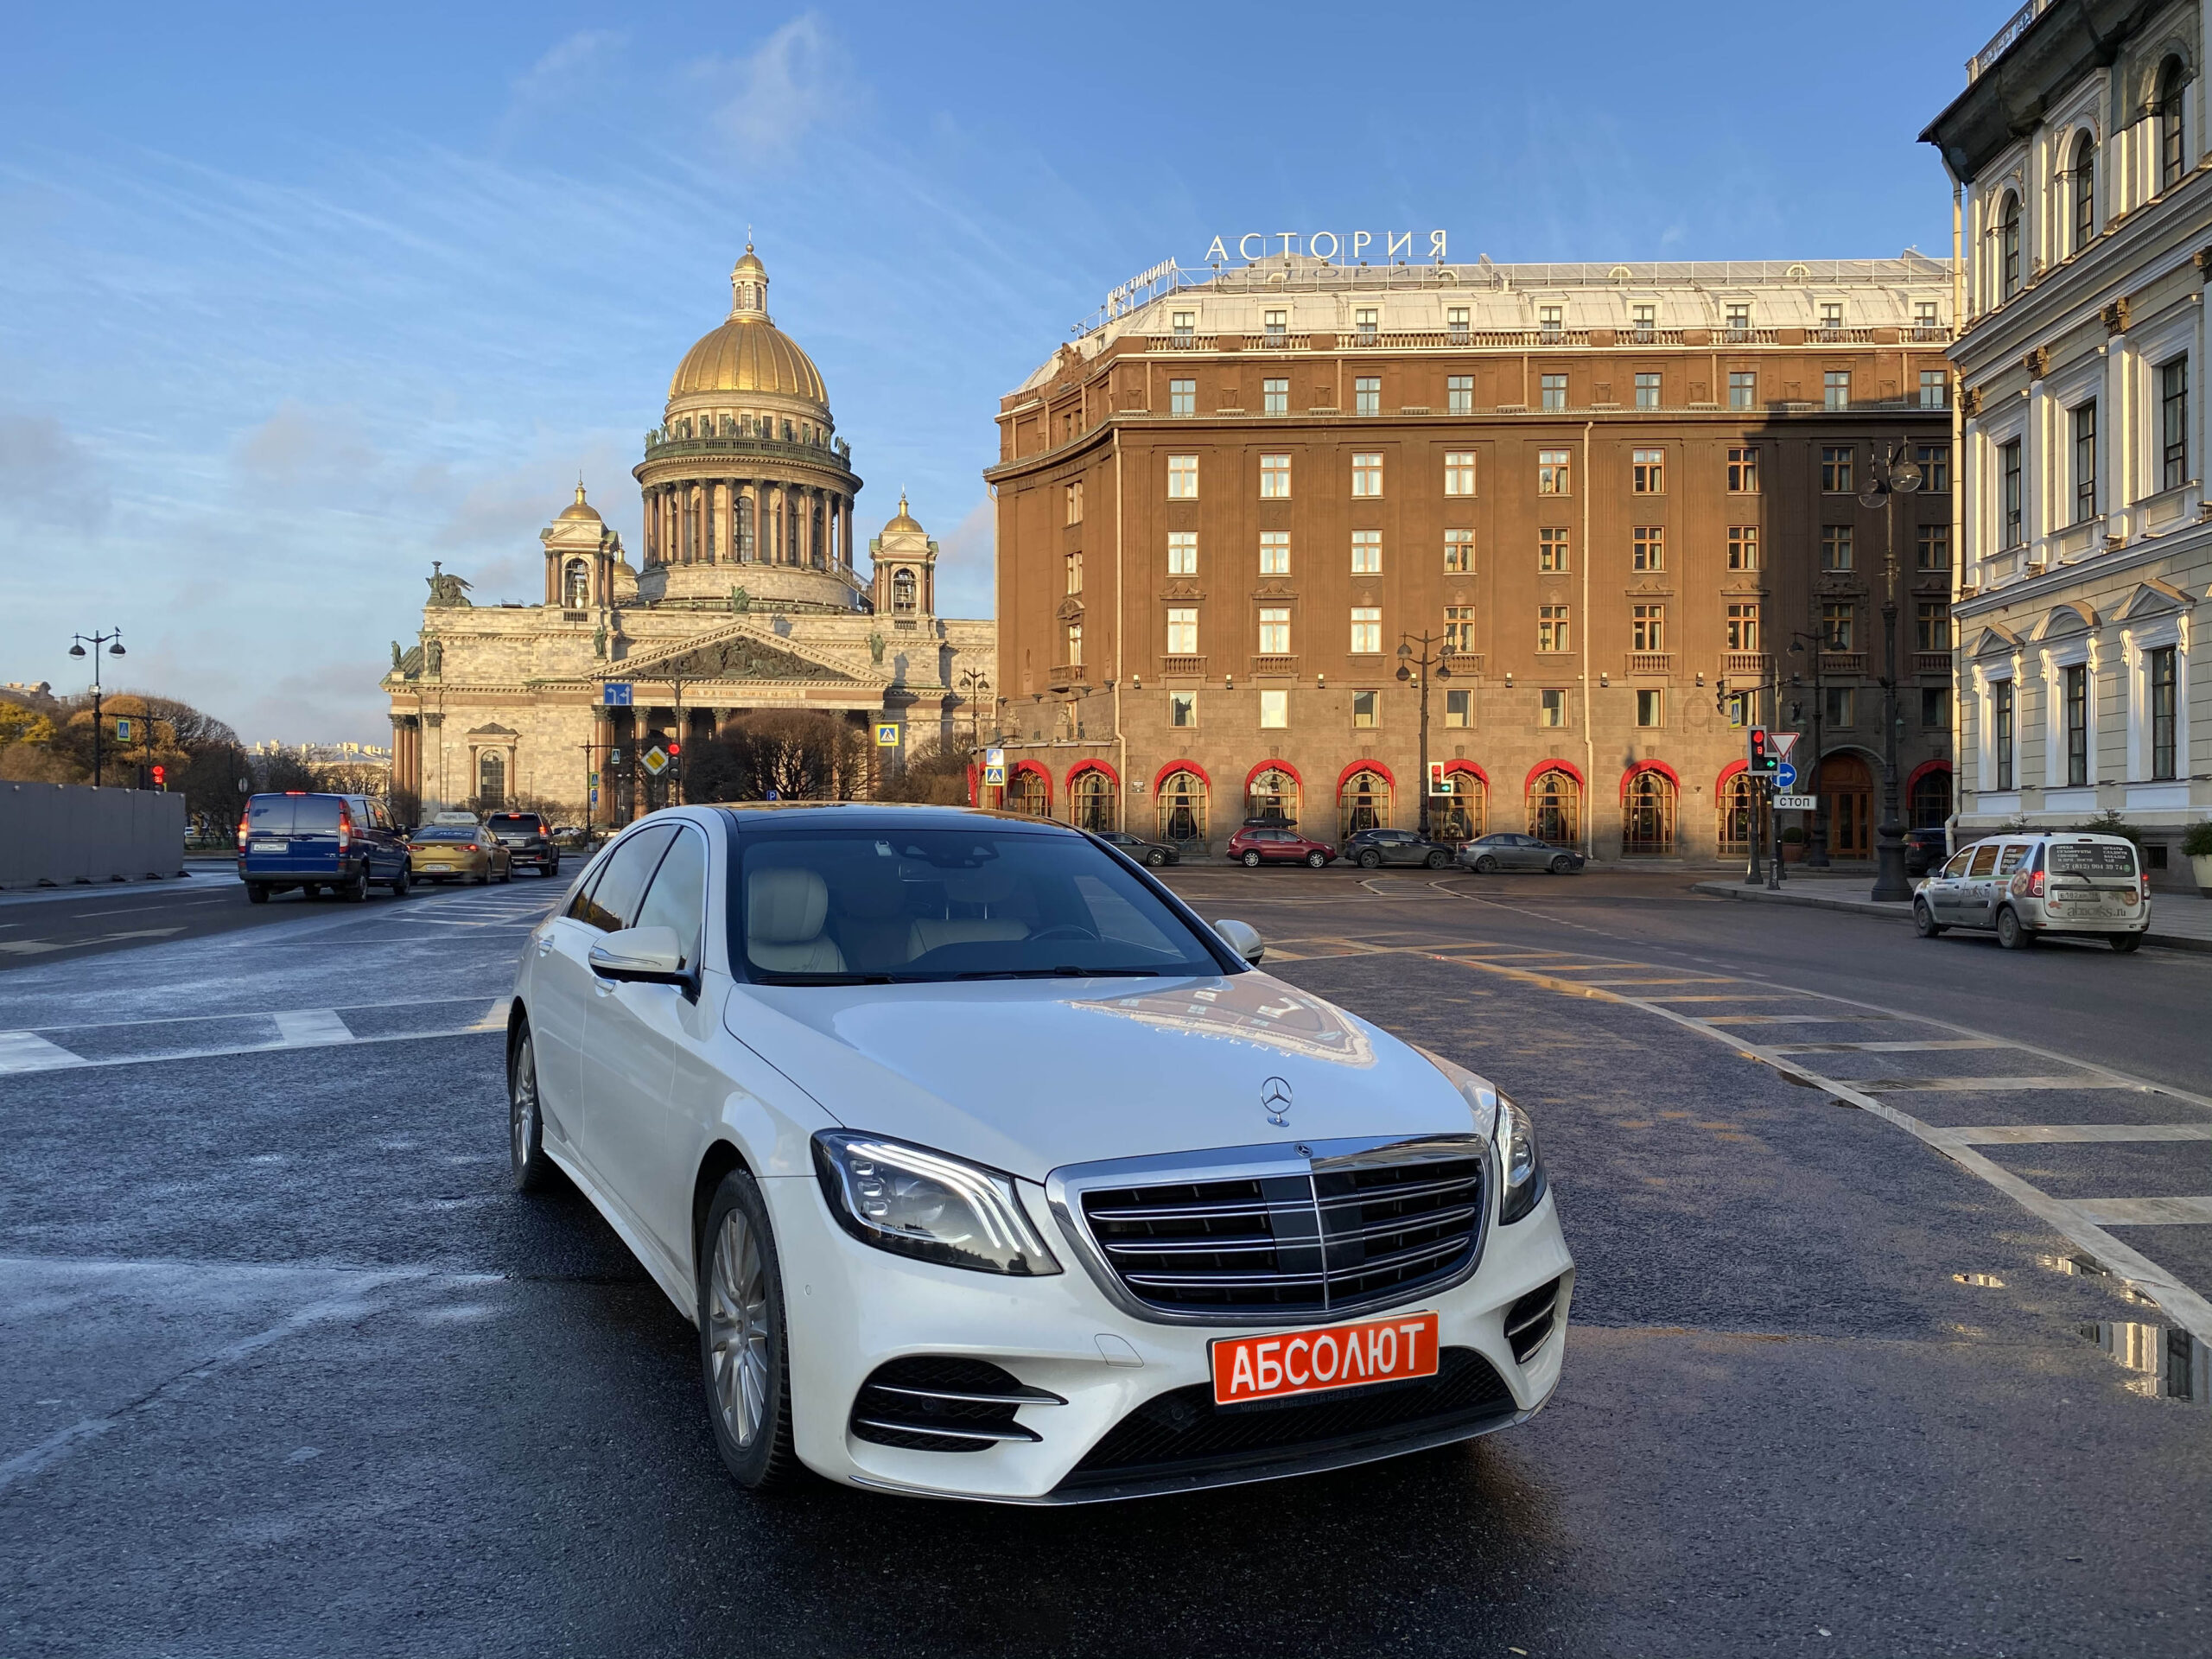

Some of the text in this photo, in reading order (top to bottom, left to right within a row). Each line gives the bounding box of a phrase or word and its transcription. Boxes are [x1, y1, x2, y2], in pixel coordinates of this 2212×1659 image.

[1204, 230, 1447, 262] АСТОРИЯ
[769, 791, 776, 801] P
[1780, 798, 1809, 806] СТОП
[1230, 1322, 1425, 1395] АБСОЛЮТ
